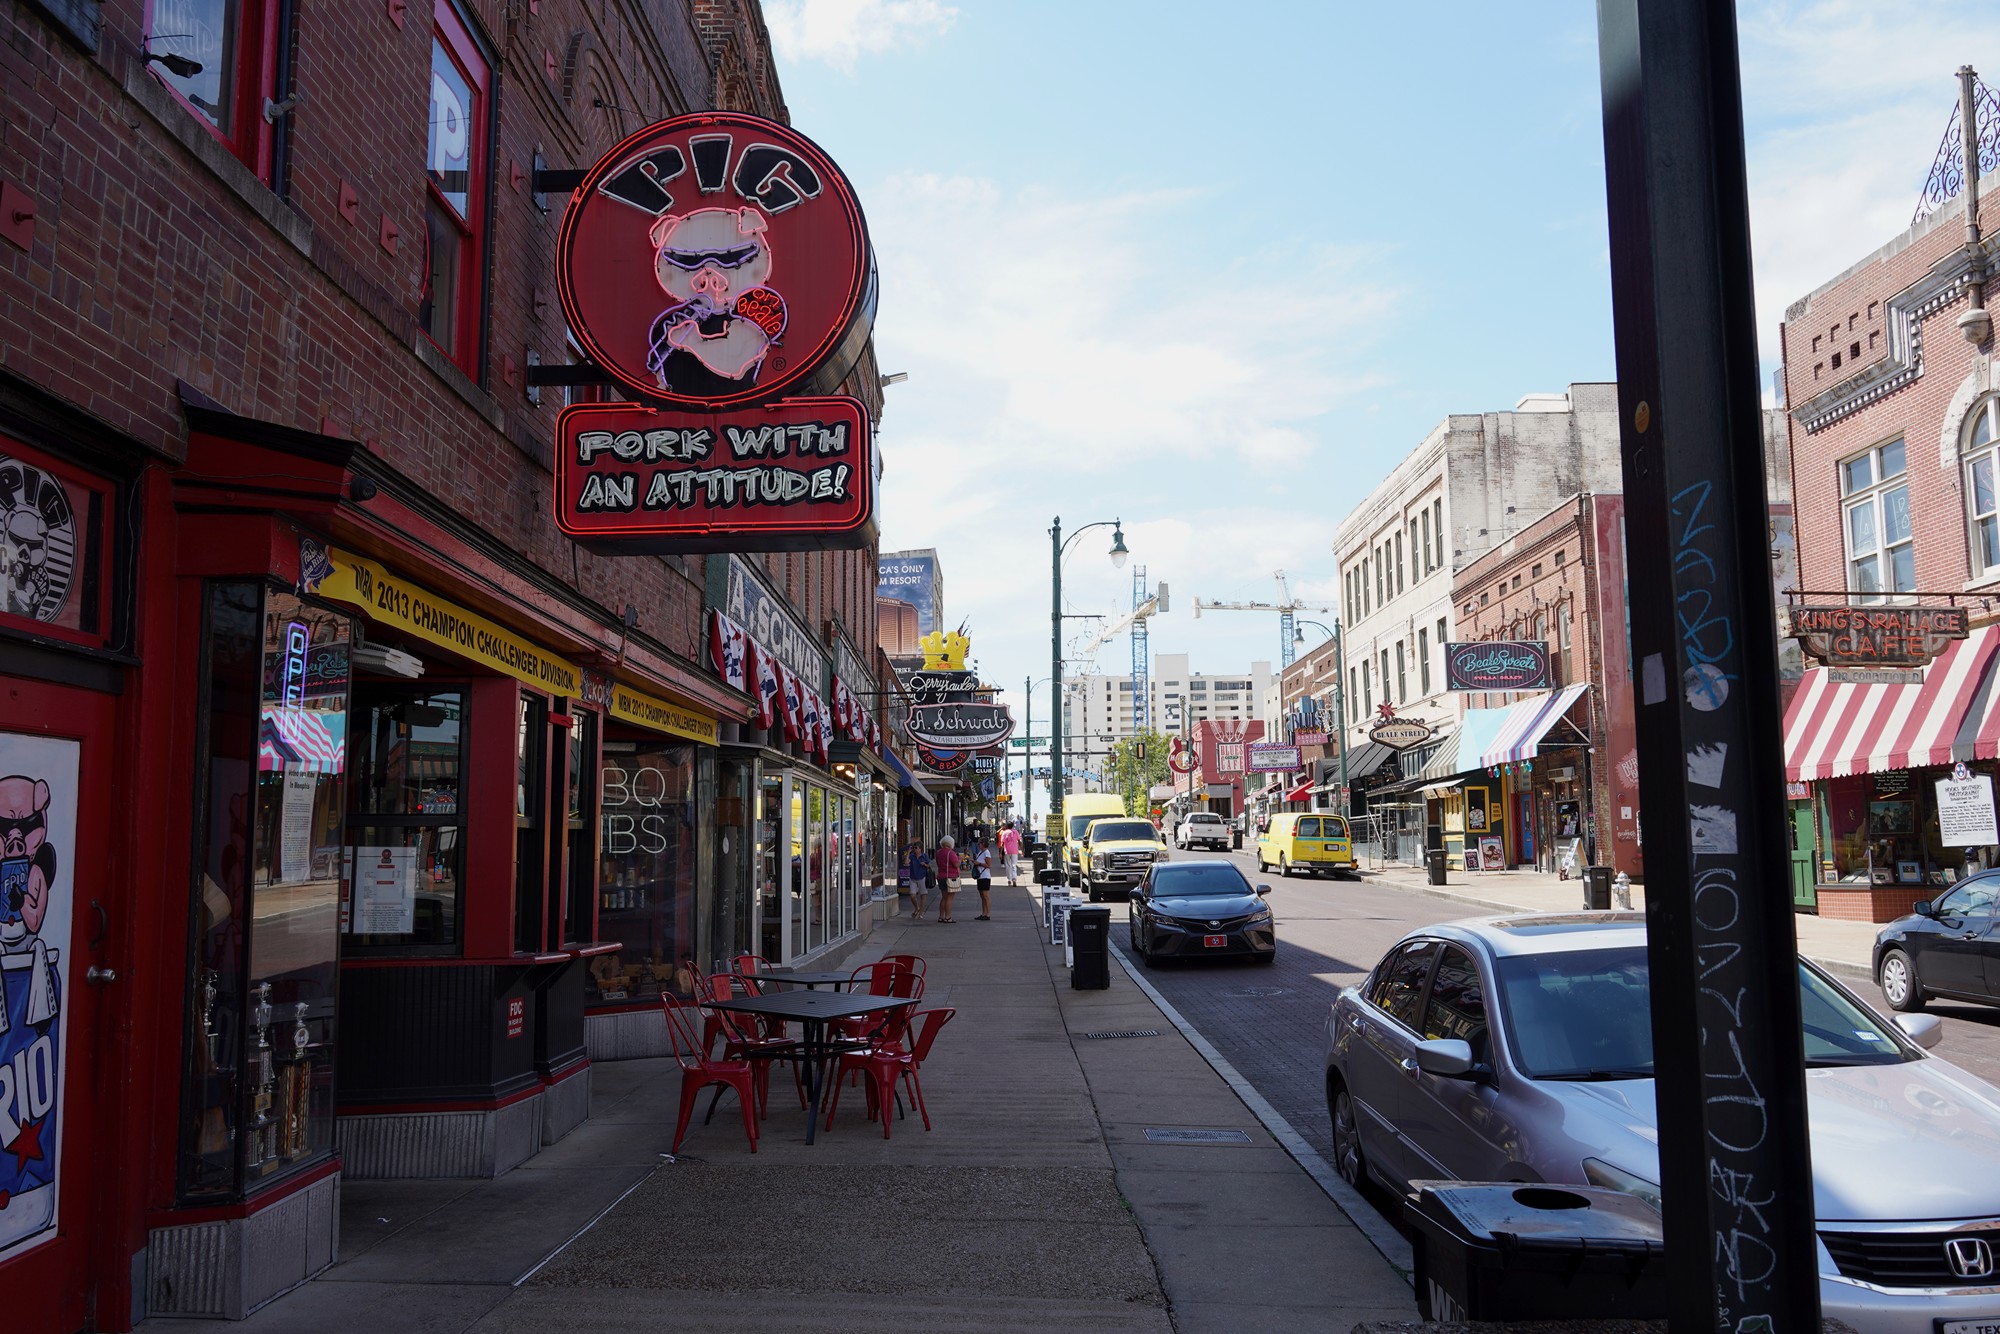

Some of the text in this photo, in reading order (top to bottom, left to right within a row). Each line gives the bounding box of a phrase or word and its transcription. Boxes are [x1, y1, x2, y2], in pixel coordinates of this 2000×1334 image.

[598, 133, 823, 216] PIG
[752, 288, 780, 306] on
[737, 298, 782, 335] Beale
[578, 424, 846, 461] PORK WITH
[579, 465, 848, 507] AN ATTITUDE!
[38, 567, 49, 580] on
[901, 565, 924, 574] ONLY
[890, 576, 921, 585] RESORT
[351, 563, 575, 692] MBN 2013 CHAMPION CHALLENGER DIVISION
[1874, 612, 1962, 633] PALACE
[757, 597, 820, 691] SCHWAB
[1835, 636, 1925, 657] CAFE
[284, 632, 306, 738] OPEN
[1830, 673, 1849, 681] AIR
[632, 698, 645, 719] 2013
[645, 704, 671, 727] CHAMPION
[671, 709, 698, 734] CHALLENGER
[697, 719, 714, 738] DIVISION
[934, 709, 1009, 730] Schwab
[929, 735, 974, 743] ESTABLISHED
[1401, 730, 1427, 738] STREET
[1221, 745, 1244, 756] BLUES
[923, 753, 936, 766] 159
[939, 752, 967, 770] BEALE
[976, 758, 993, 768] BLUES
[1221, 756, 1244, 771] CAFE
[510, 1001, 523, 1016] FDC
